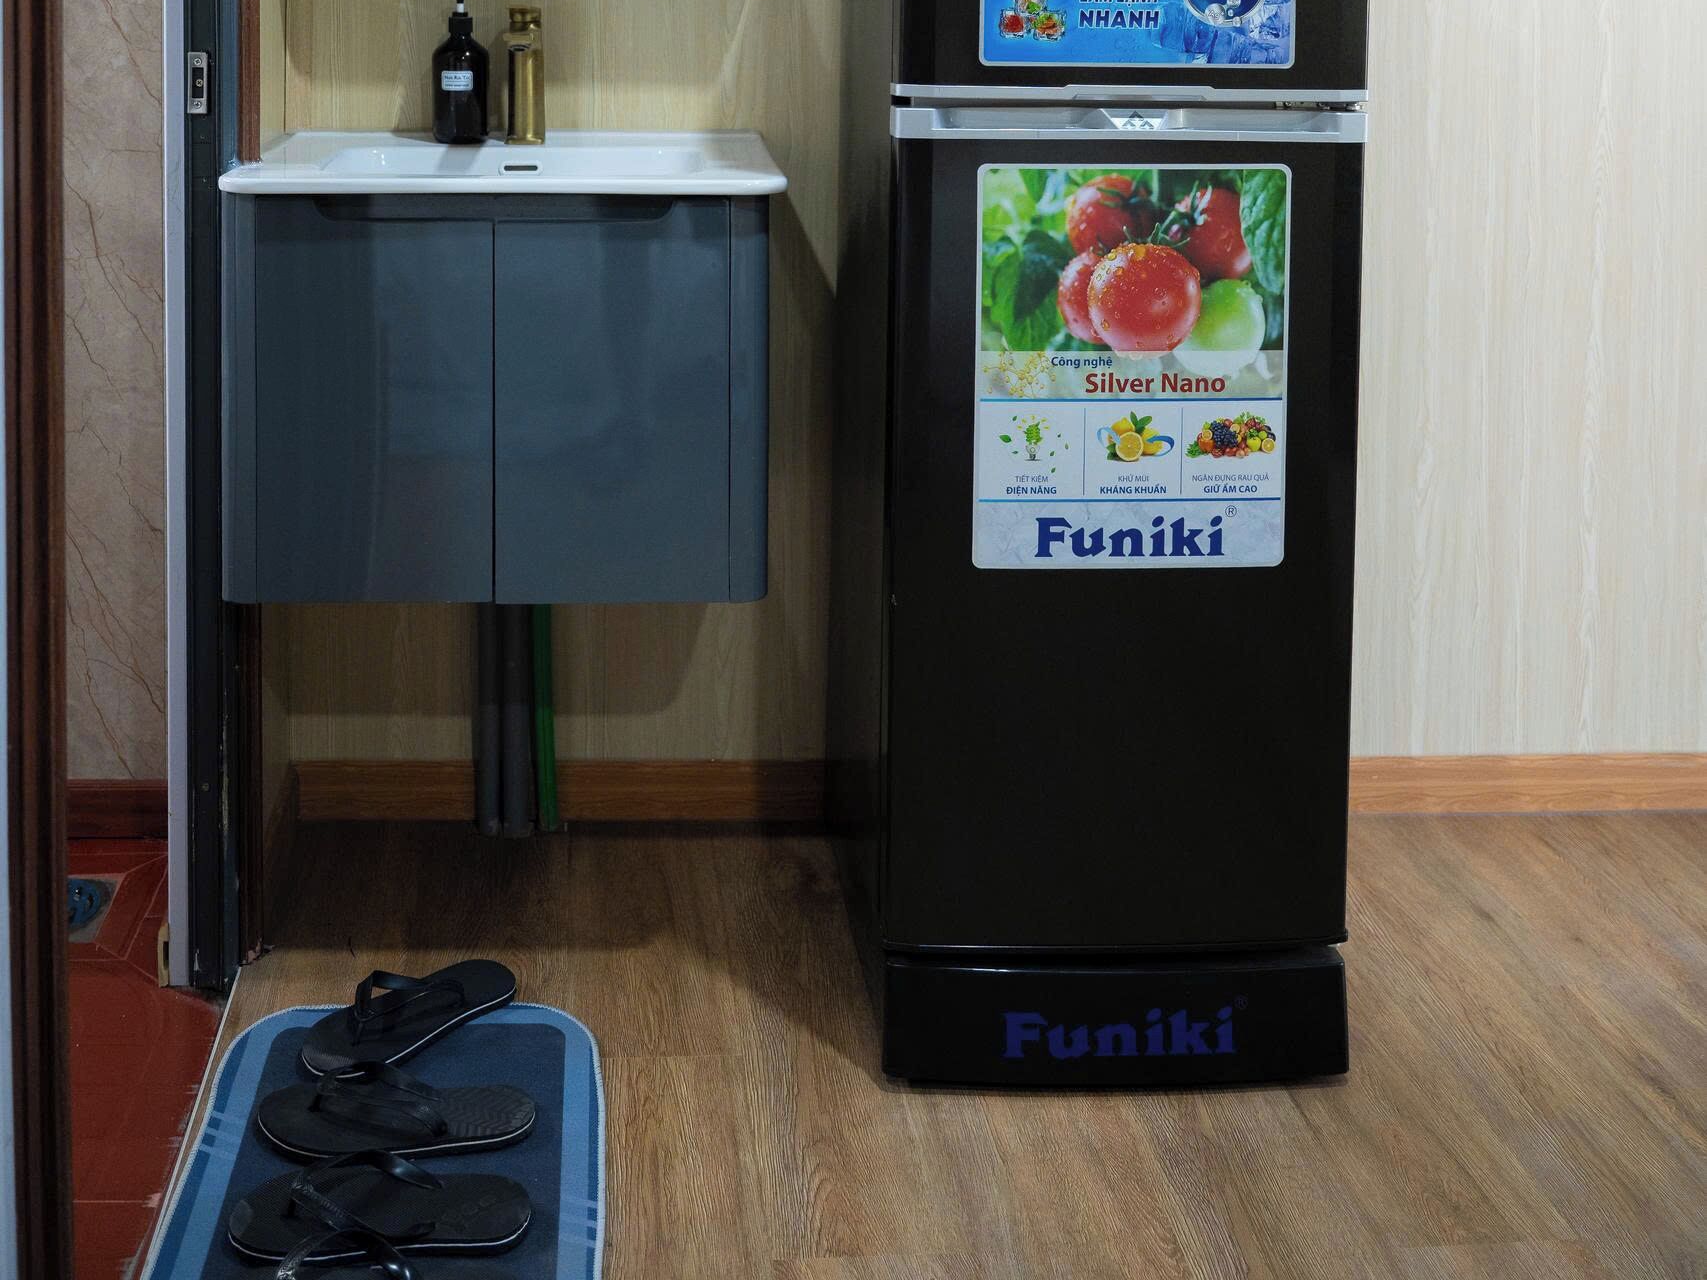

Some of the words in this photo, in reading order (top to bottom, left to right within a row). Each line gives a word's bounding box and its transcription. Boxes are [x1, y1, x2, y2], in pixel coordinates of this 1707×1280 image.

[1078, 9, 1160, 29] NHANH
[1051, 356, 1081, 369] Công
[1083, 356, 1113, 369] nghệ
[1085, 372, 1154, 394] Silver
[1161, 373, 1226, 393] Nano
[1006, 485, 1028, 497] ĐIỆN
[1100, 484, 1133, 494] KHÁNG
[1203, 483, 1221, 494] GIỮ
[1238, 485, 1258, 493] CAO
[1034, 515, 1225, 558] Funiki
[1000, 1006, 1237, 1061] Funiki
